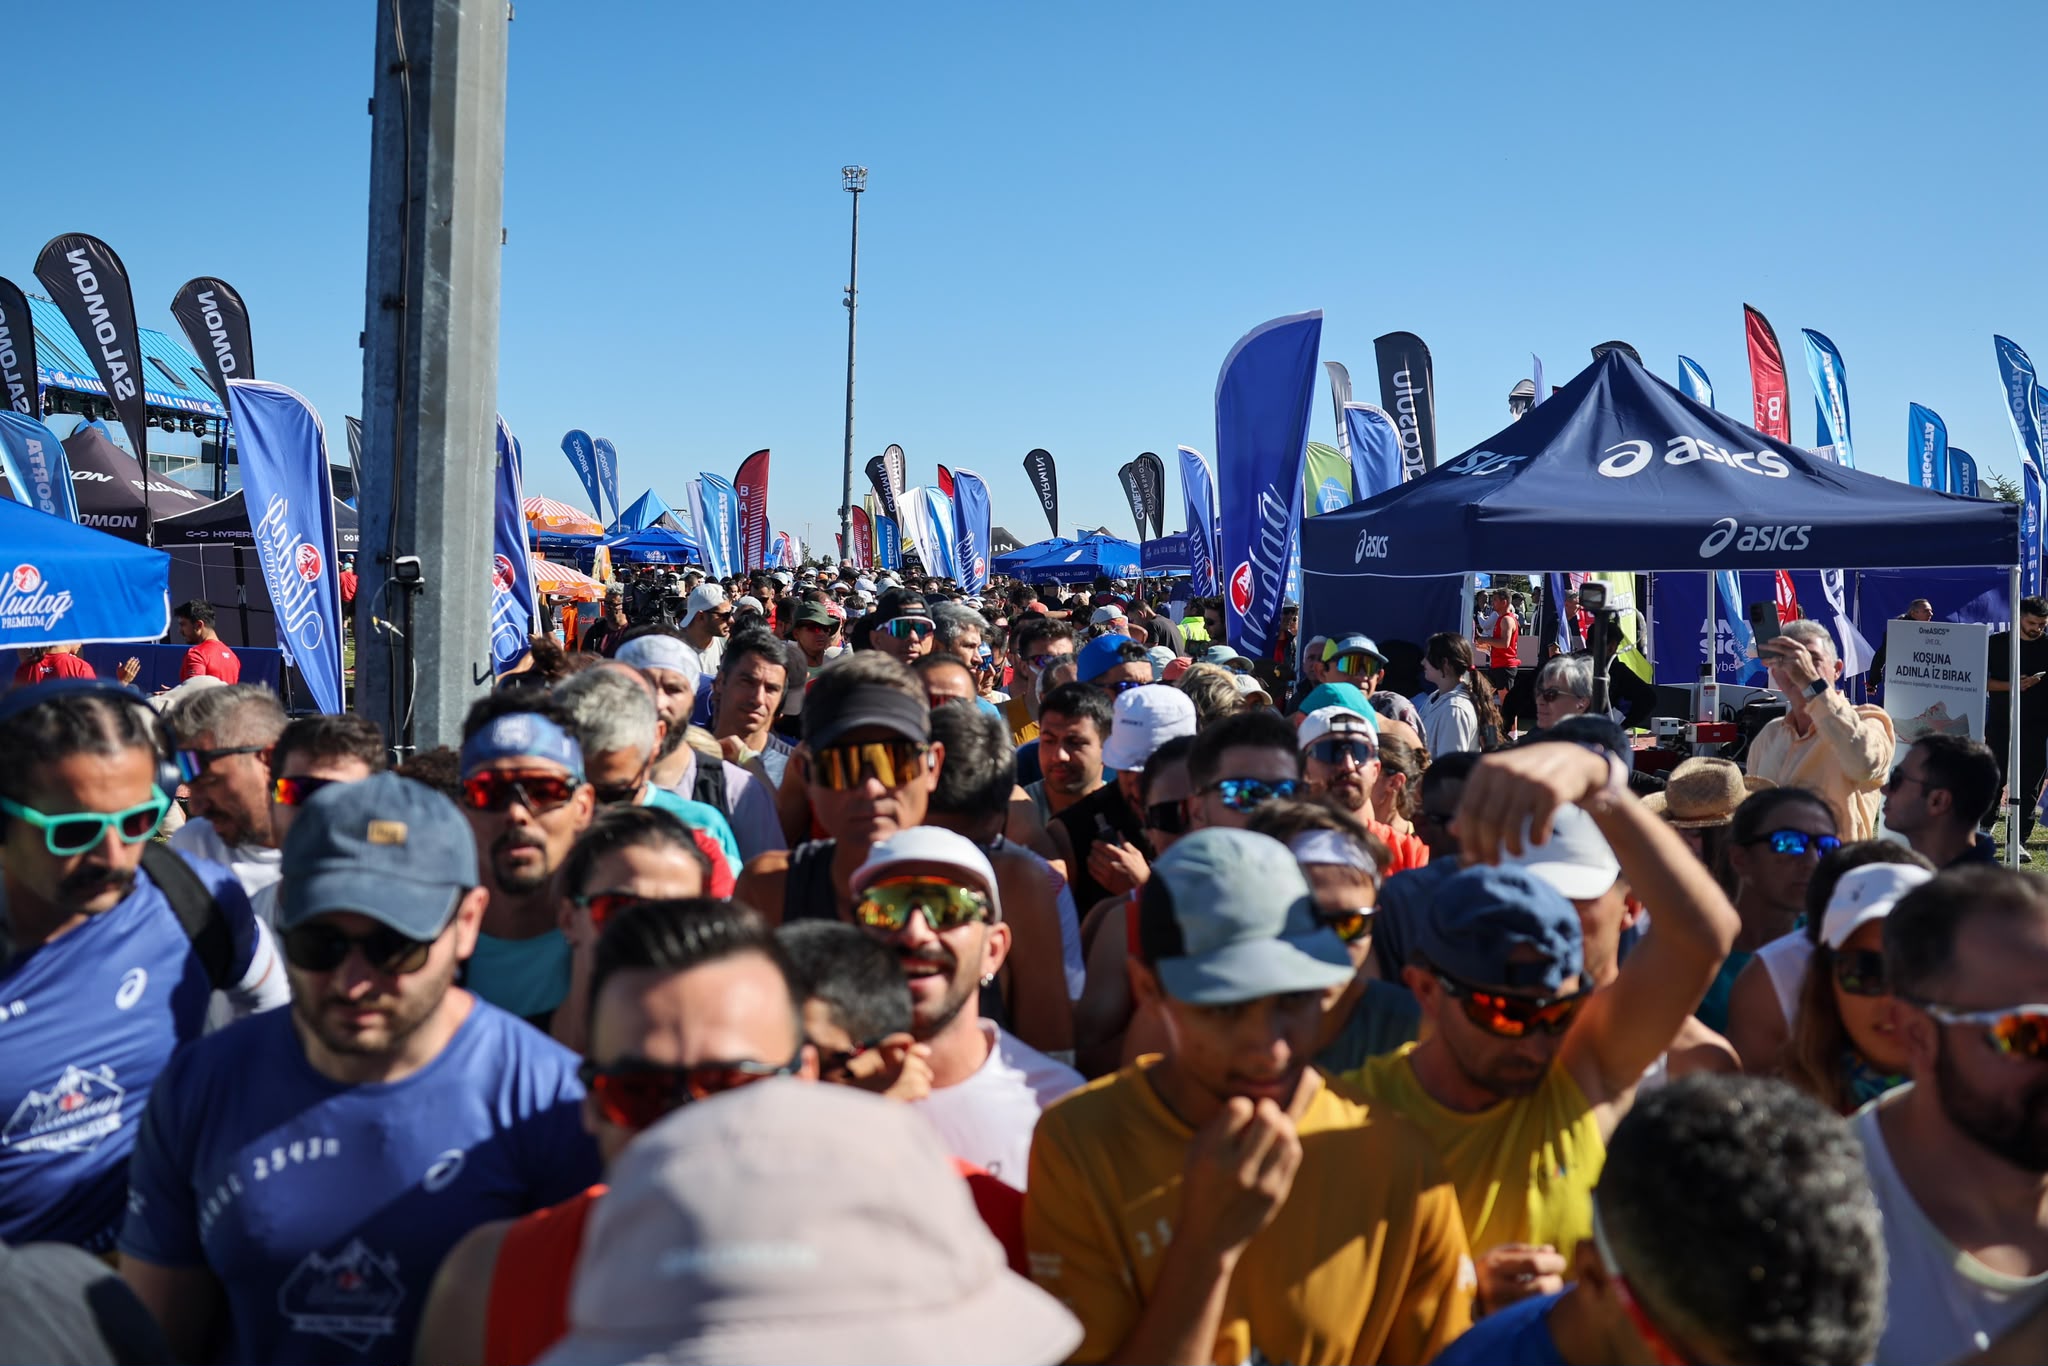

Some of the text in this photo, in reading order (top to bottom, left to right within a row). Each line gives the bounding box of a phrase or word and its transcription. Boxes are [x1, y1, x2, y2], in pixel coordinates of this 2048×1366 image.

[1, 615, 45, 629] PREMIUM
[1913, 651, 1951, 667] KOŞUNA
[1895, 665, 1972, 683] ADINLA İZ BIRAK
